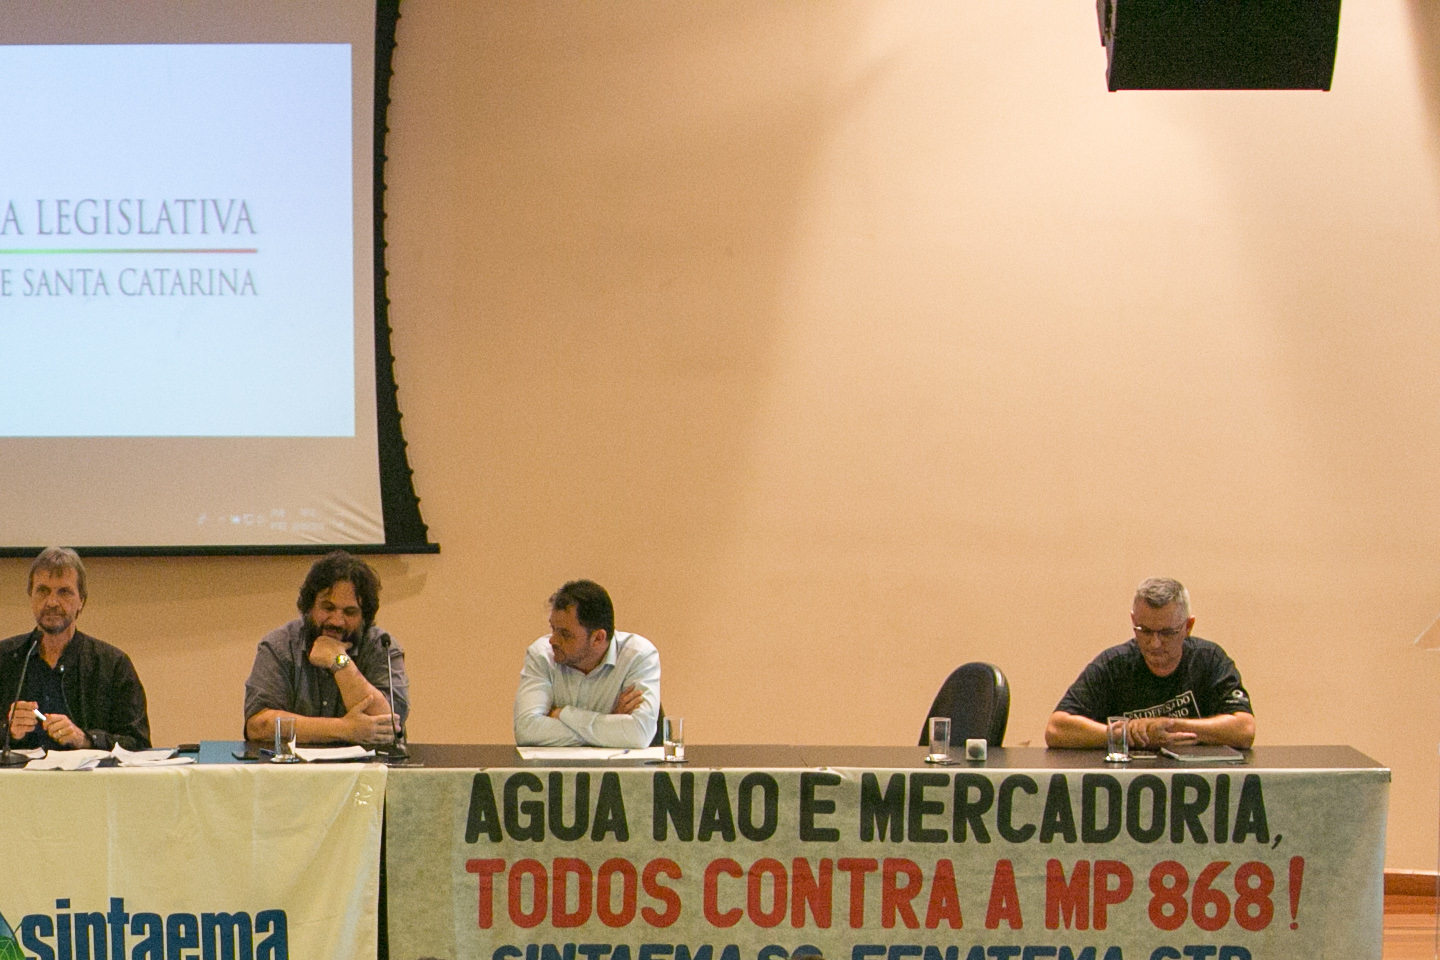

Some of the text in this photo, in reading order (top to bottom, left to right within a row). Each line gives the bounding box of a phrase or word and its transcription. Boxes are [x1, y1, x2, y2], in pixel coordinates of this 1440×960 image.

[36, 198, 257, 235] LEGISLATIVA
[23, 268, 110, 296] SANTA
[118, 267, 258, 296] CATARINA
[860, 772, 1283, 850] MERCADORIA,
[465, 857, 683, 930] TODOS
[703, 857, 964, 930] CONTRA
[984, 858, 1024, 930] A
[1045, 858, 1134, 931] MP
